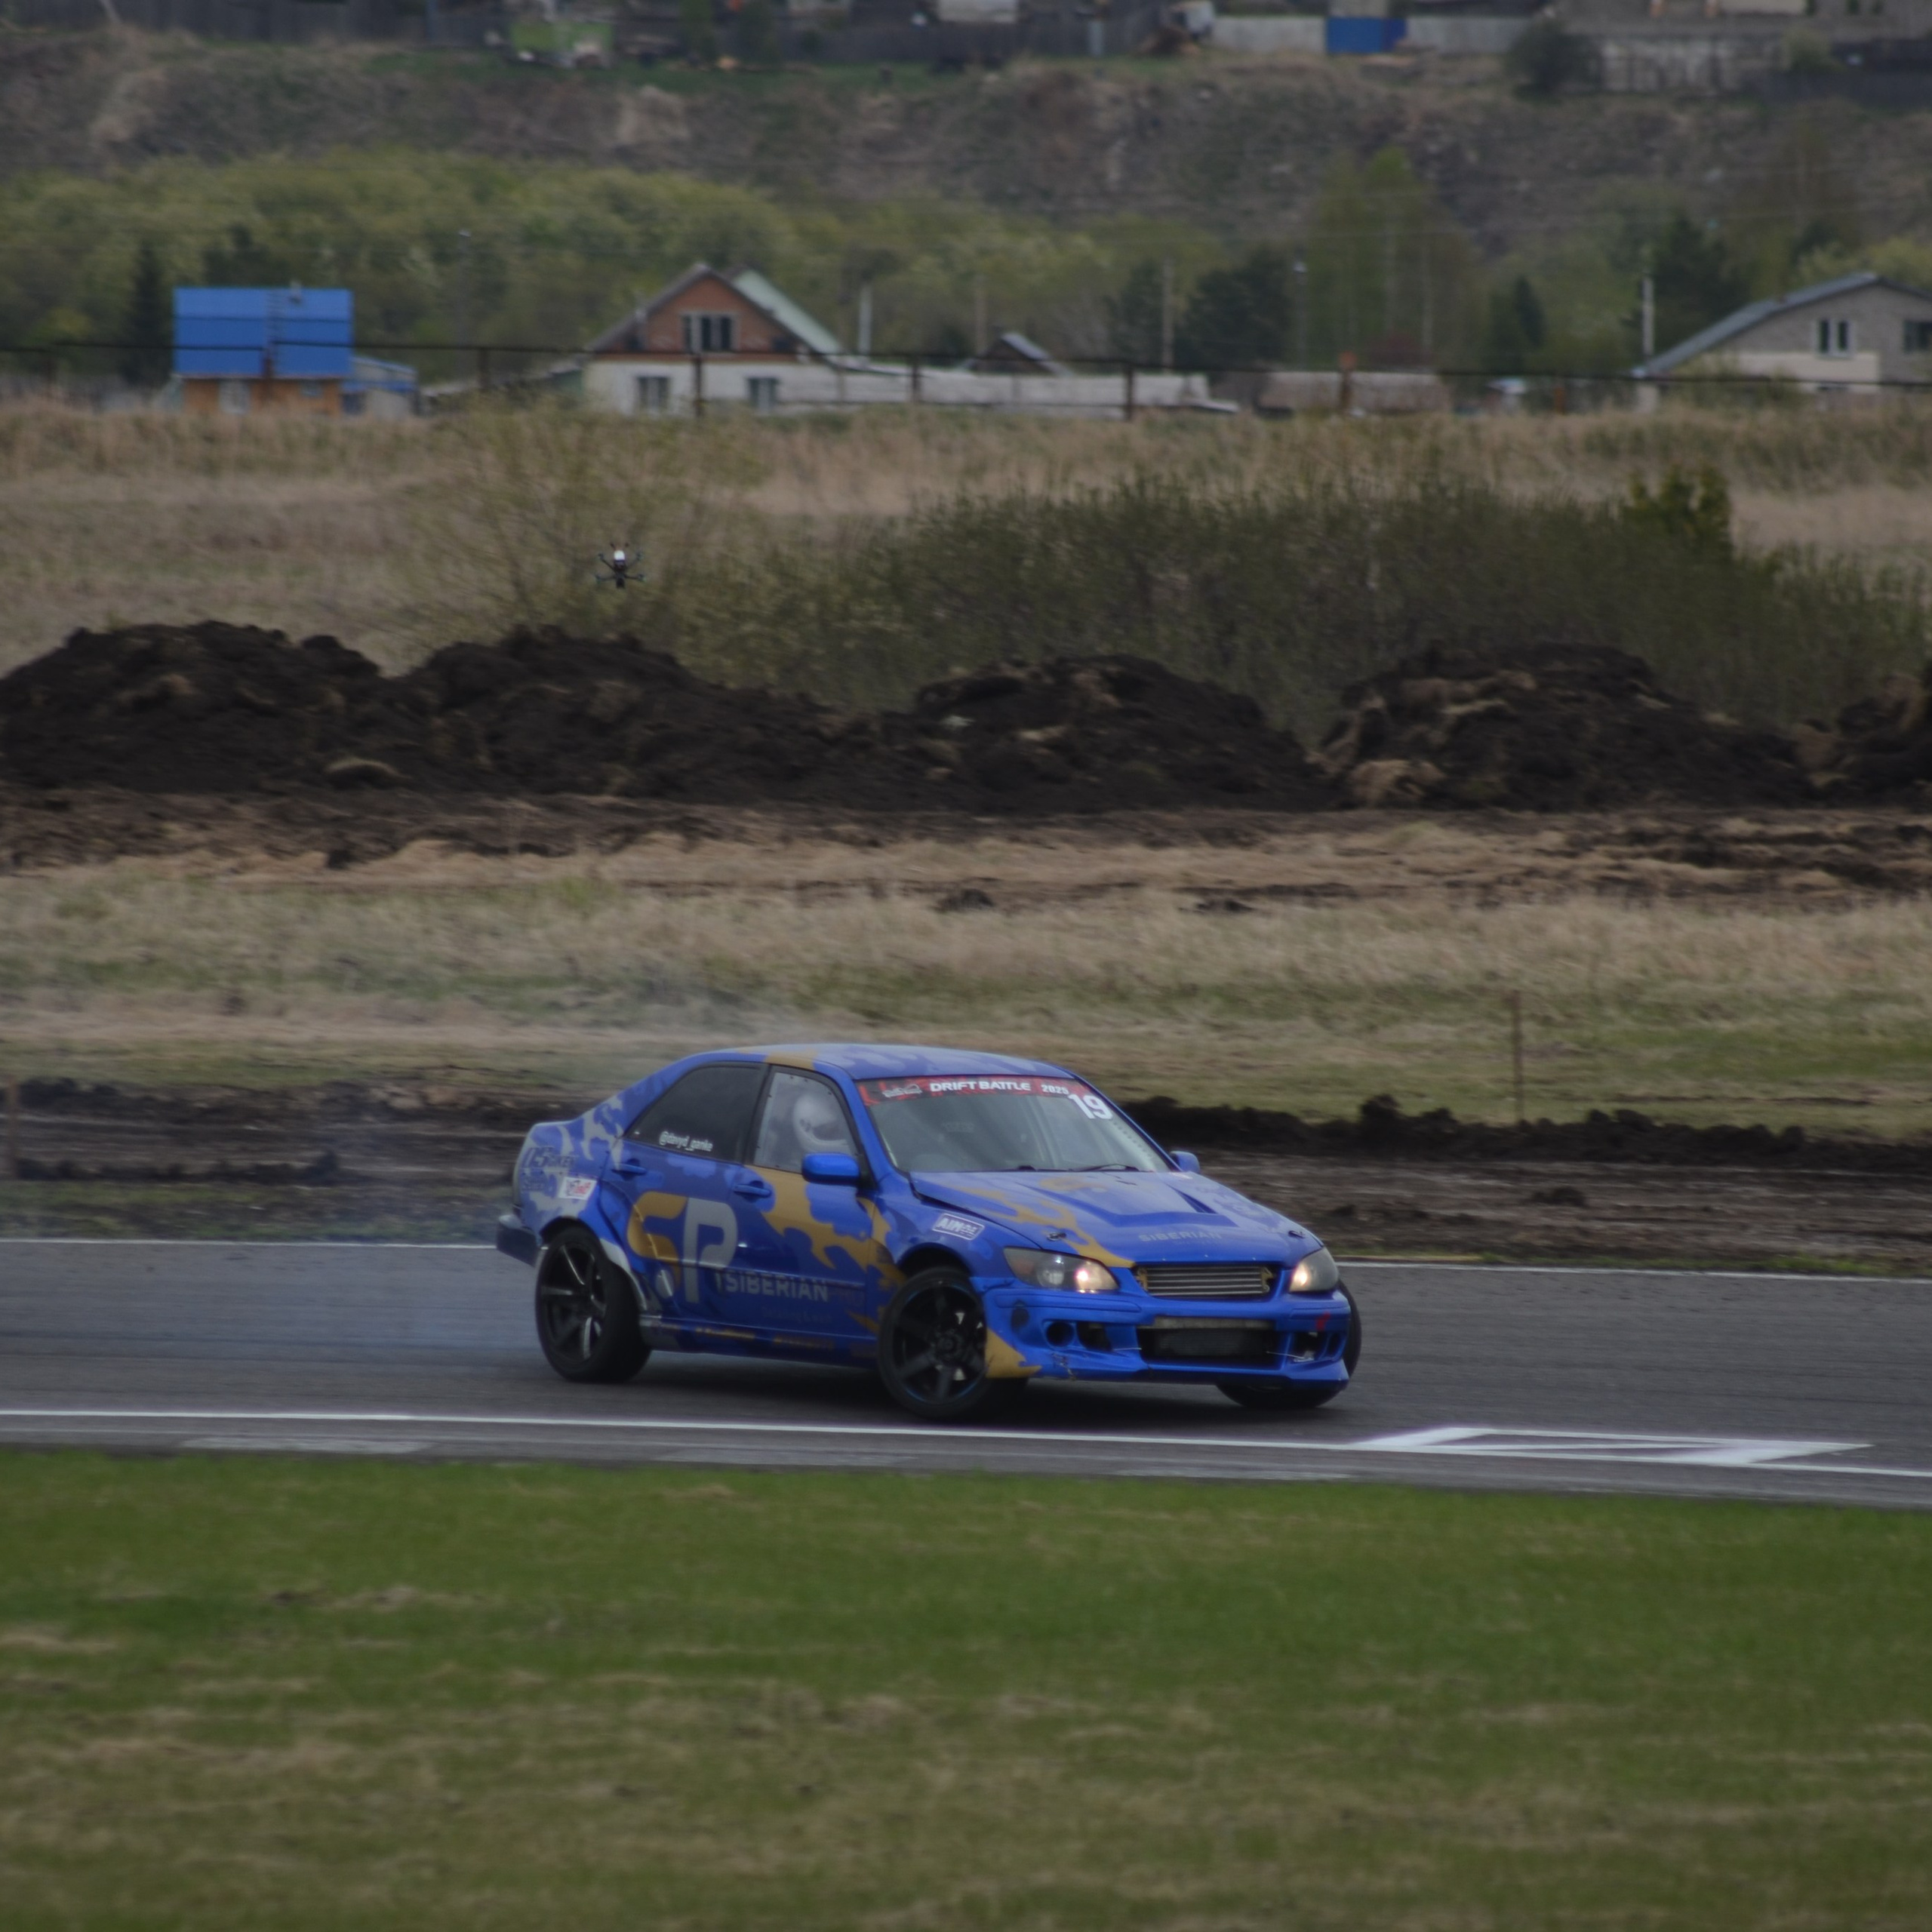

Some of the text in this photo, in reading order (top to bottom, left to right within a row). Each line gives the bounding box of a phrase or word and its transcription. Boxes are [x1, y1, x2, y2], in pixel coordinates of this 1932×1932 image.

[929, 1080, 977, 1093] DRIFT
[979, 1080, 1032, 1092] BATTLE
[1067, 1094, 1114, 1121] 19
[1137, 1230, 1223, 1242] SIBERIAN
[724, 1269, 829, 1303] SIBERIAN
